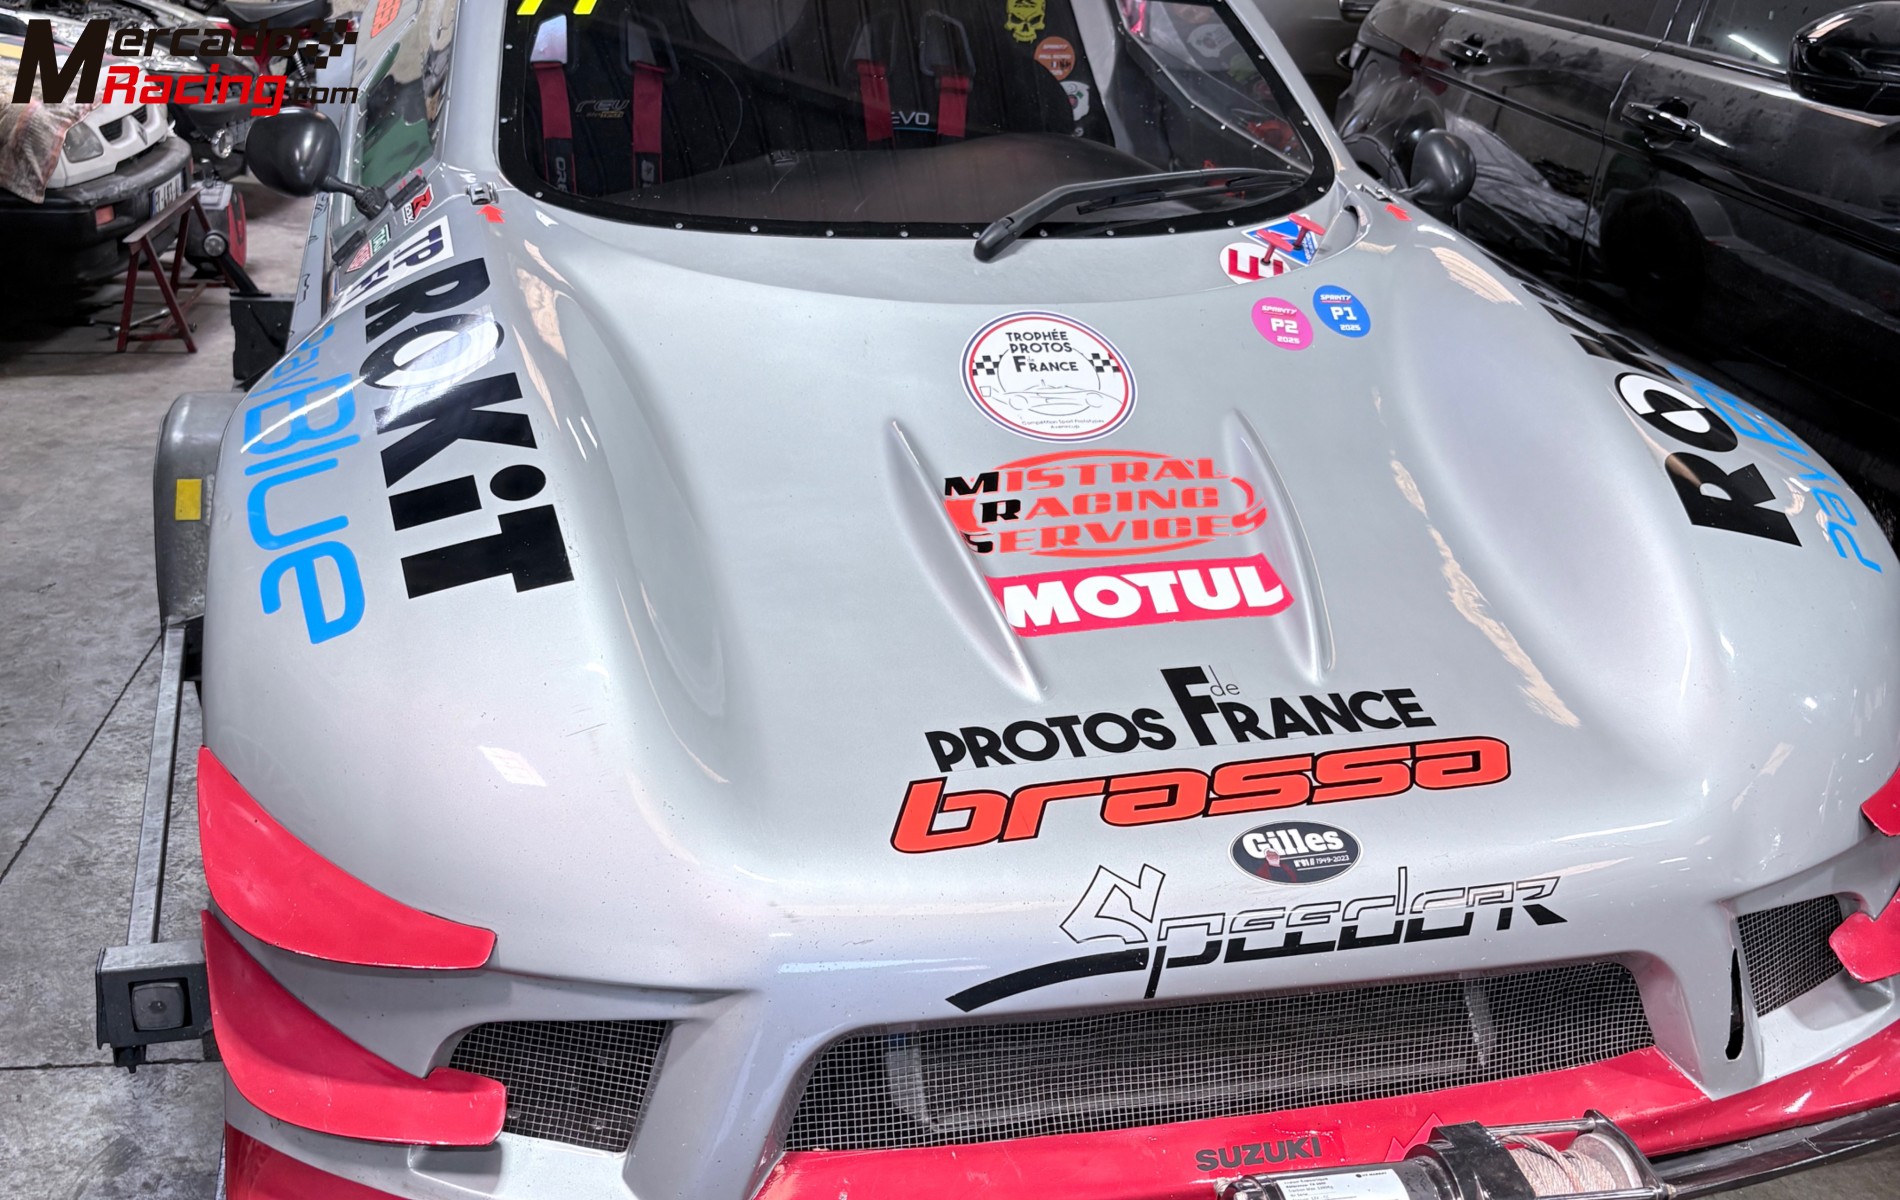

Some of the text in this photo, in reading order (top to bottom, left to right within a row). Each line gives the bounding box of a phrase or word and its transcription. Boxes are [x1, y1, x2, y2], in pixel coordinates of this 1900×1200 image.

[1262, 304, 1298, 315] SPRINTY
[1270, 318, 1299, 334] P2
[1330, 306, 1358, 321] P1
[1005, 328, 1069, 342] TROPHÉE
[1009, 342, 1073, 354] PROTOS
[1276, 335, 1300, 344] 2025
[943, 457, 1231, 497] MISTRAL
[981, 486, 1219, 523] RACING
[1003, 565, 1284, 629] MOTUL
[1208, 664, 1241, 698] de
[1159, 665, 1437, 747] FRANCE
[925, 708, 1177, 773] PROTOS
[890, 736, 1512, 854] brassa
[1242, 828, 1344, 859] Gilles
[1195, 1136, 1323, 1172] SUZUKI
